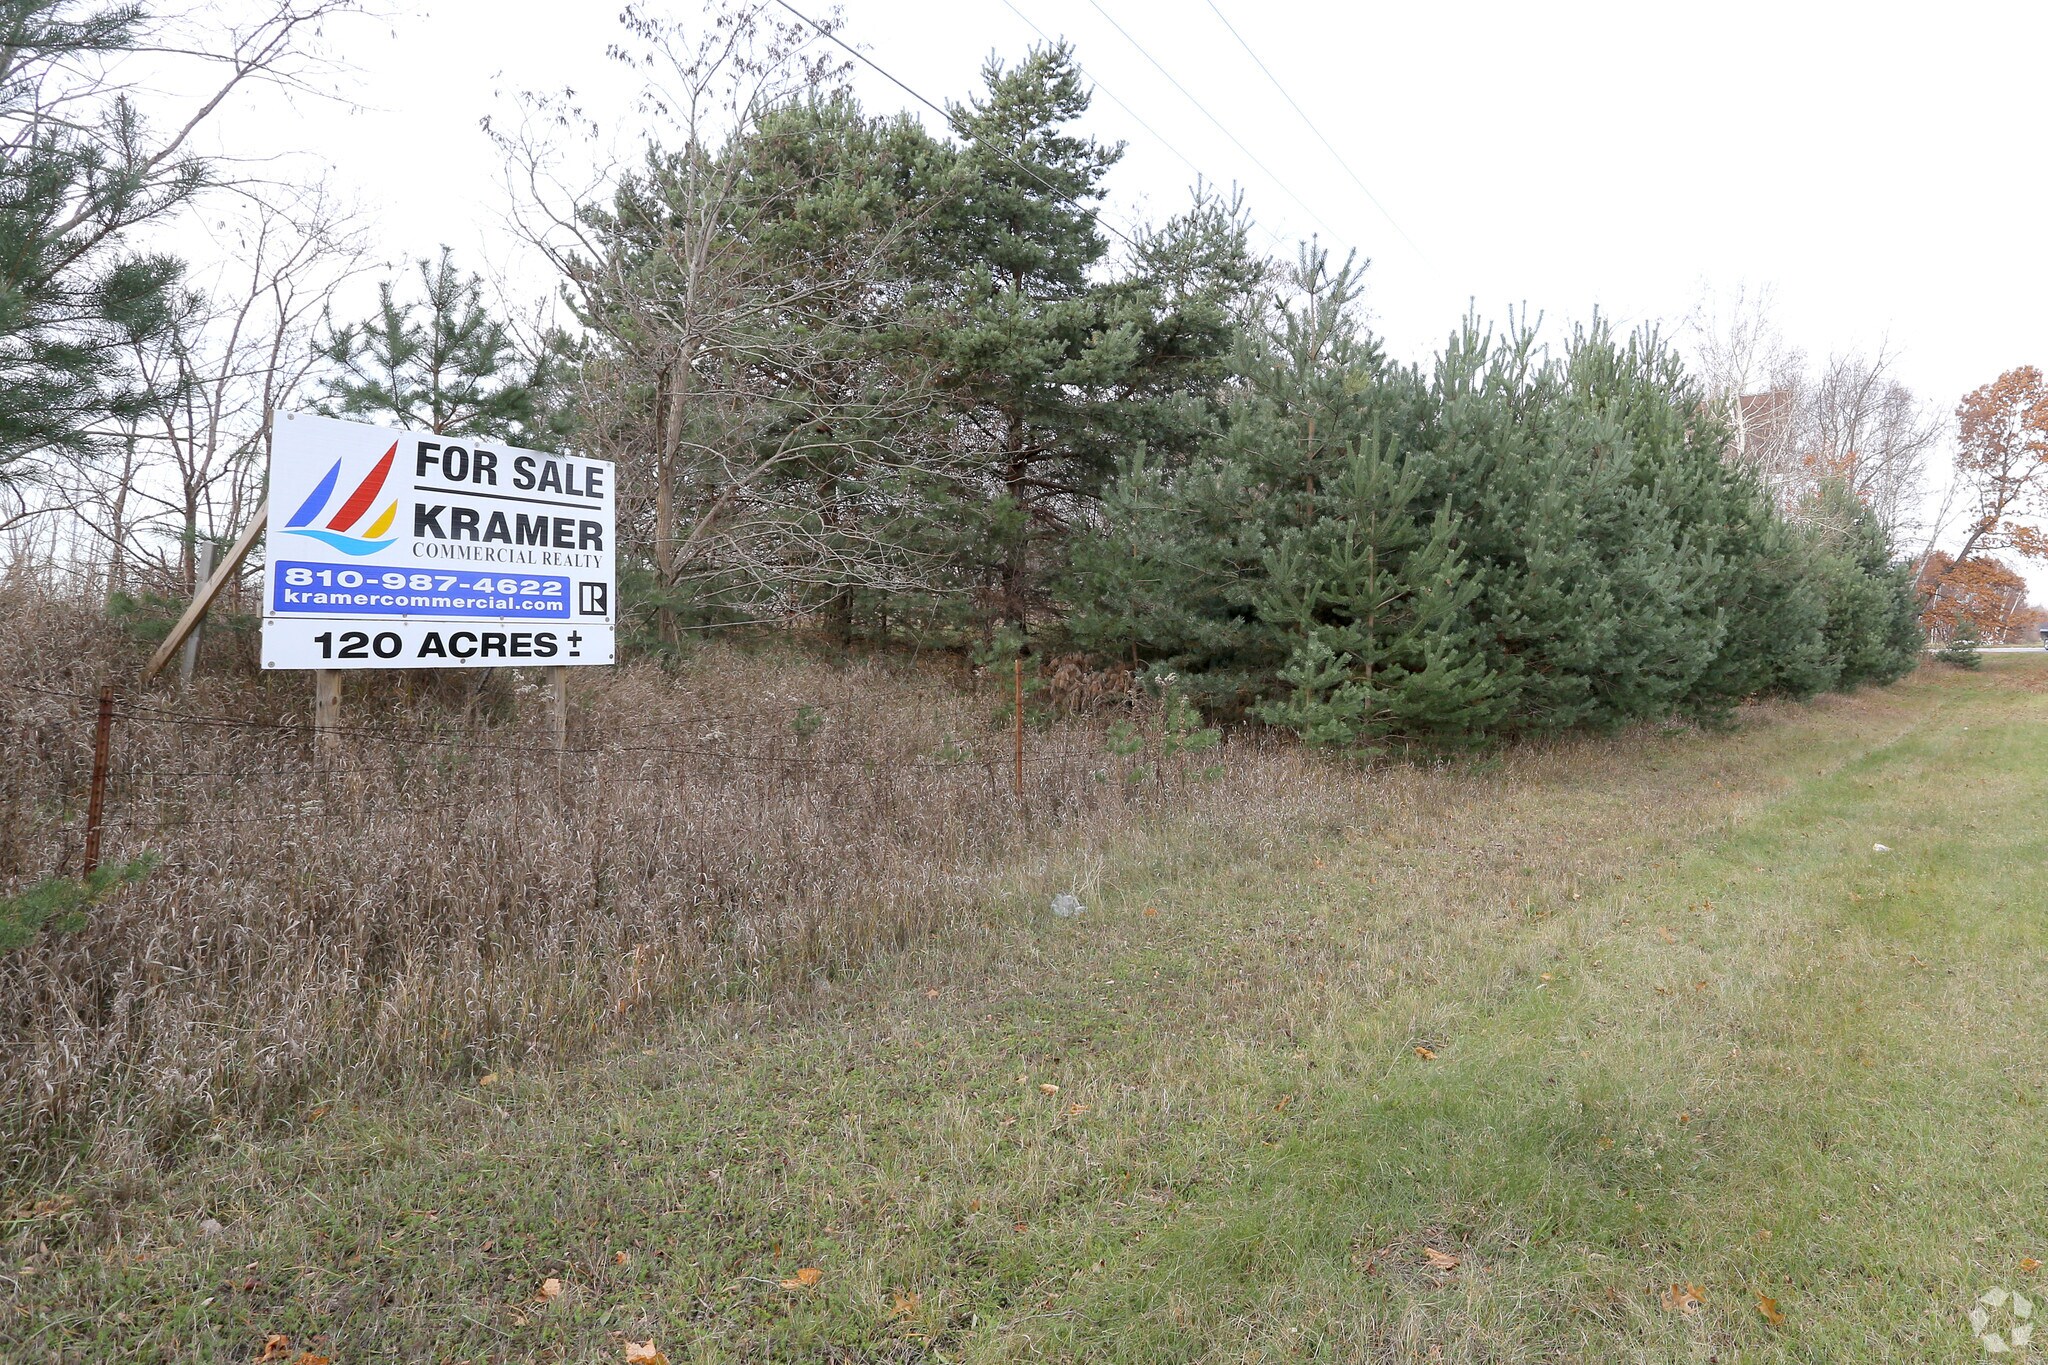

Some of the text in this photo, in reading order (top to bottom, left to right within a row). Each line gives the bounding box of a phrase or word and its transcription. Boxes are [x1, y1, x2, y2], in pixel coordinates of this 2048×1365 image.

[416, 441, 604, 499] FOR SALE
[414, 503, 603, 551] KRAMER
[413, 541, 603, 569] COMMERCIAL REALTY
[284, 567, 562, 596] 810-987-4622
[284, 589, 563, 612] kramercommercial.com
[314, 631, 402, 659] 120
[417, 632, 558, 658] ACRES
